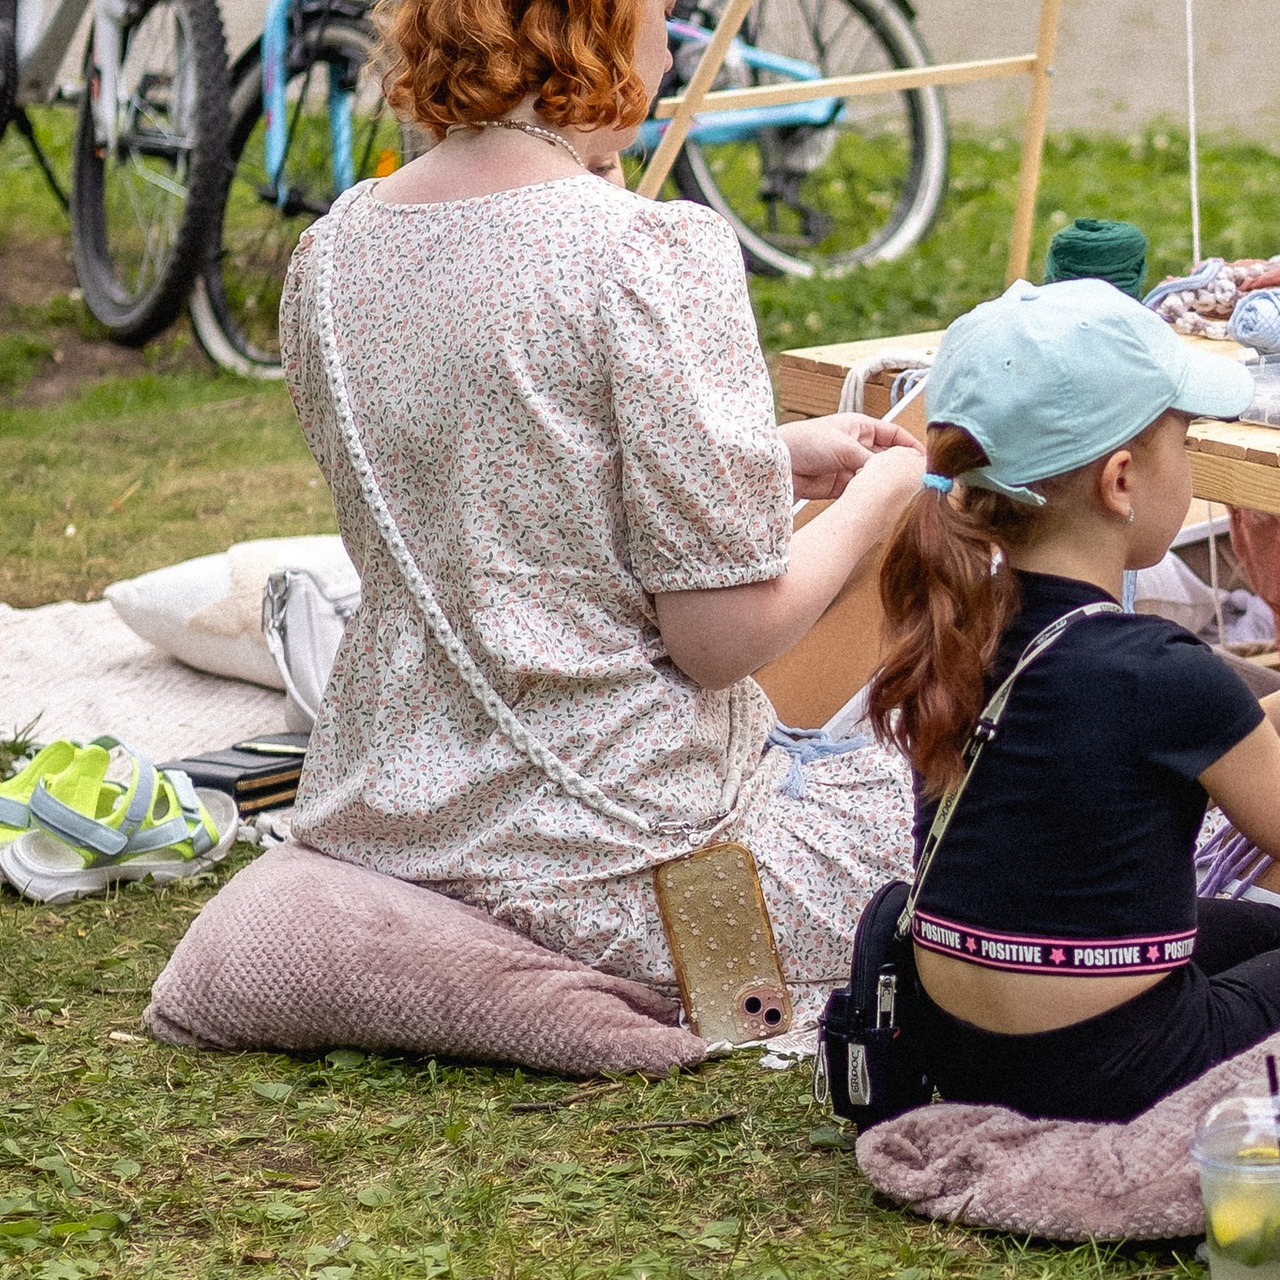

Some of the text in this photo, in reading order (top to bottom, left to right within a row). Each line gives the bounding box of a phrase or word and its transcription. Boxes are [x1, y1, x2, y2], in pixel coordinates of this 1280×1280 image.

[921, 921, 961, 949] POSITIVE
[981, 940, 1042, 963] POSITIVE
[1074, 946, 1140, 966] POSITIVE
